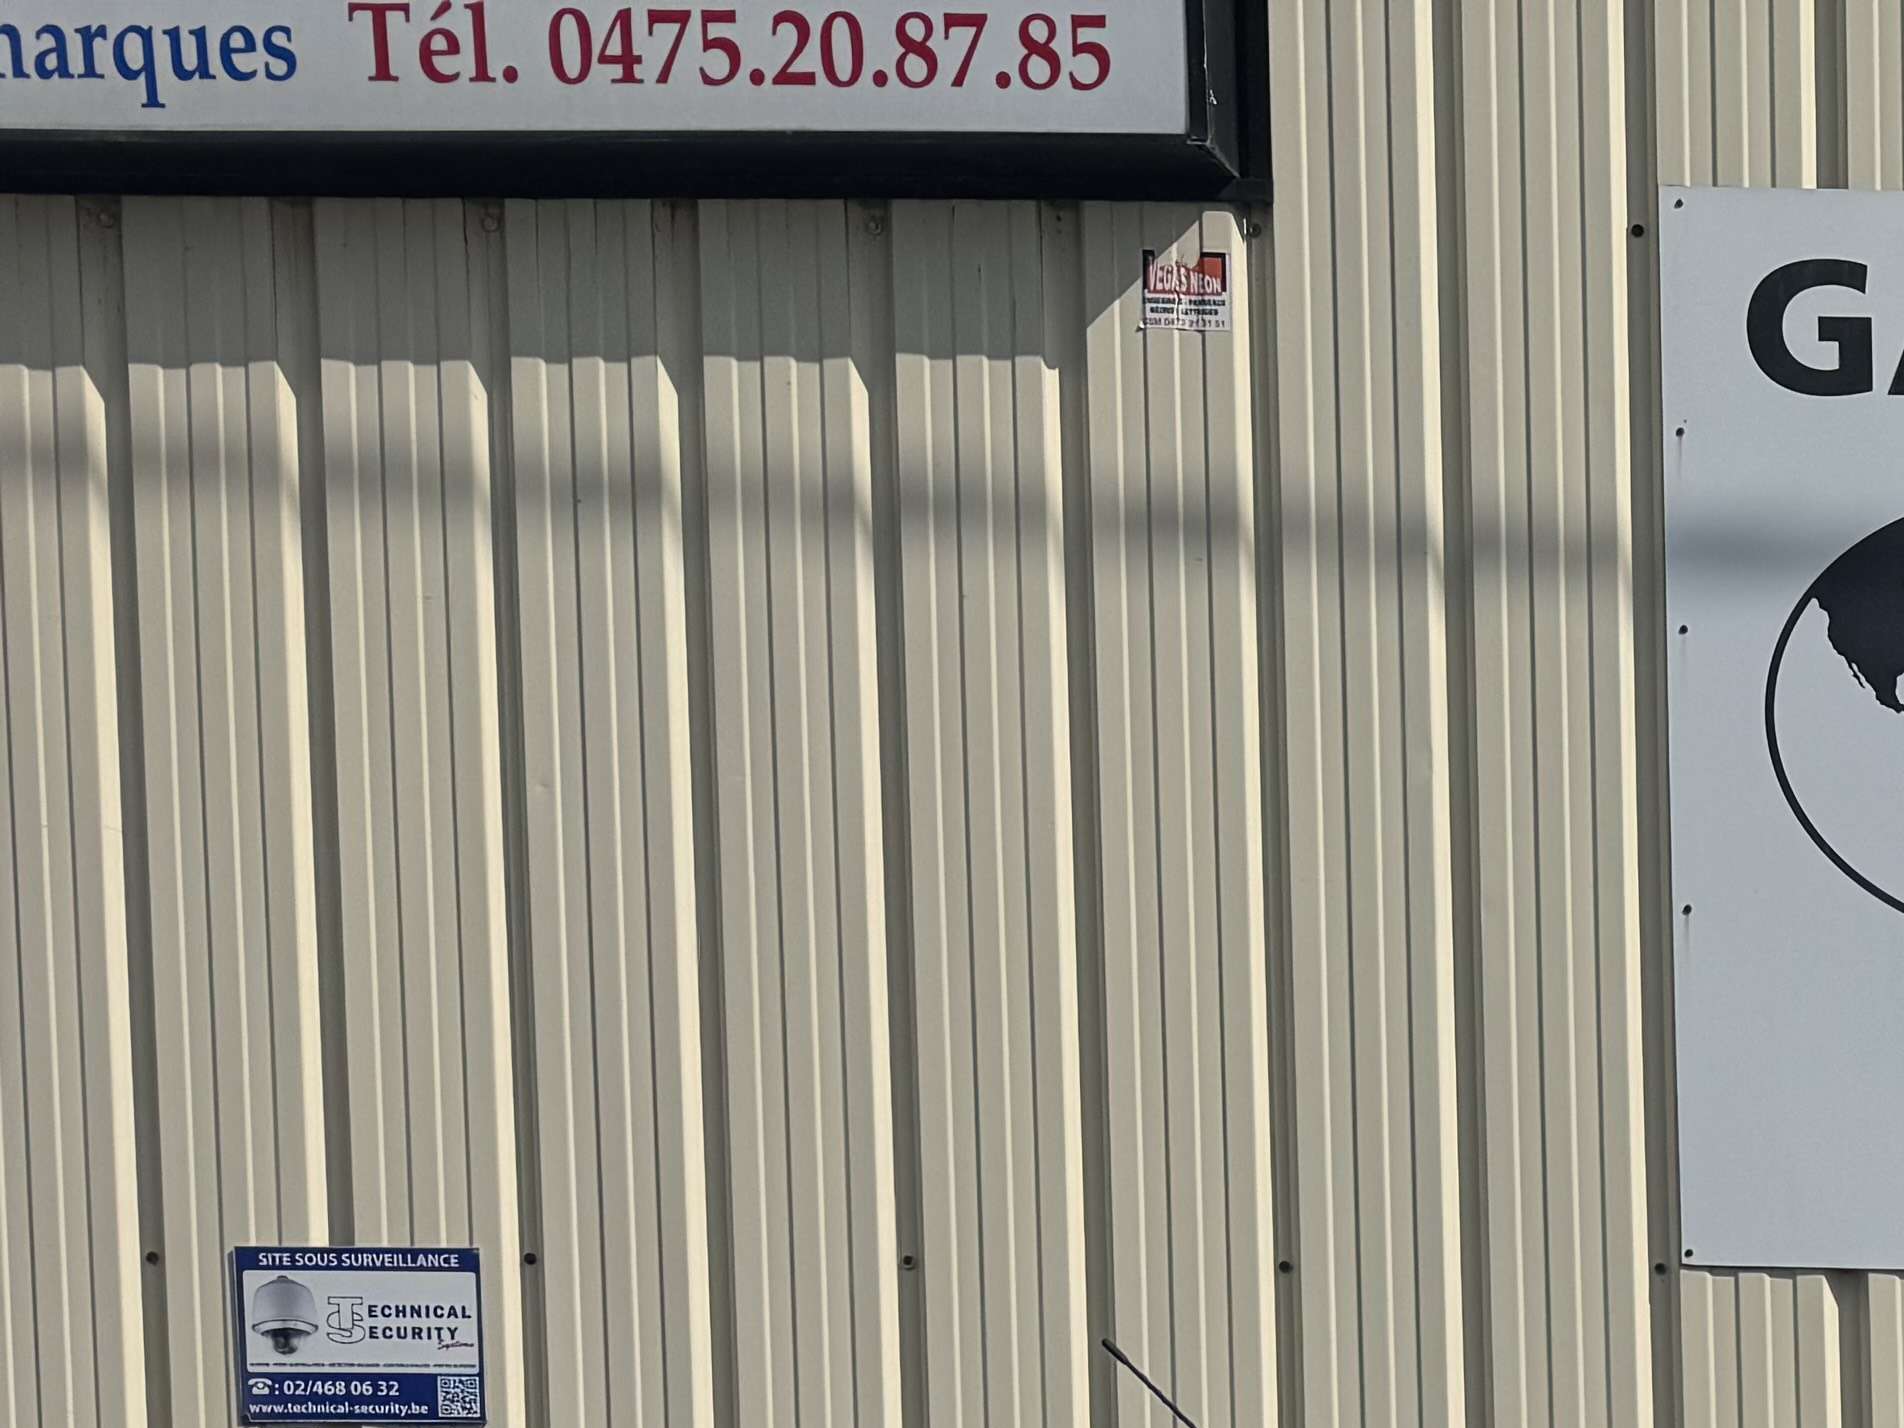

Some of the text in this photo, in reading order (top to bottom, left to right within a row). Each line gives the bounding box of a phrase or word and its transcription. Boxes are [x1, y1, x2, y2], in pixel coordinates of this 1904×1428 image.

[348, 0, 519, 84] Tél.
[548, 7, 1112, 91] 0475.20.87.85
[1149, 262, 1222, 294] VEGAS NEON
[258, 1252, 459, 1268] SITE SOUS SURVEILLANCE
[283, 1380, 346, 1396] 02/468
[350, 1382, 373, 1396] 06
[377, 1382, 400, 1396] 32
[249, 1401, 429, 1416] www.technical-security.be
